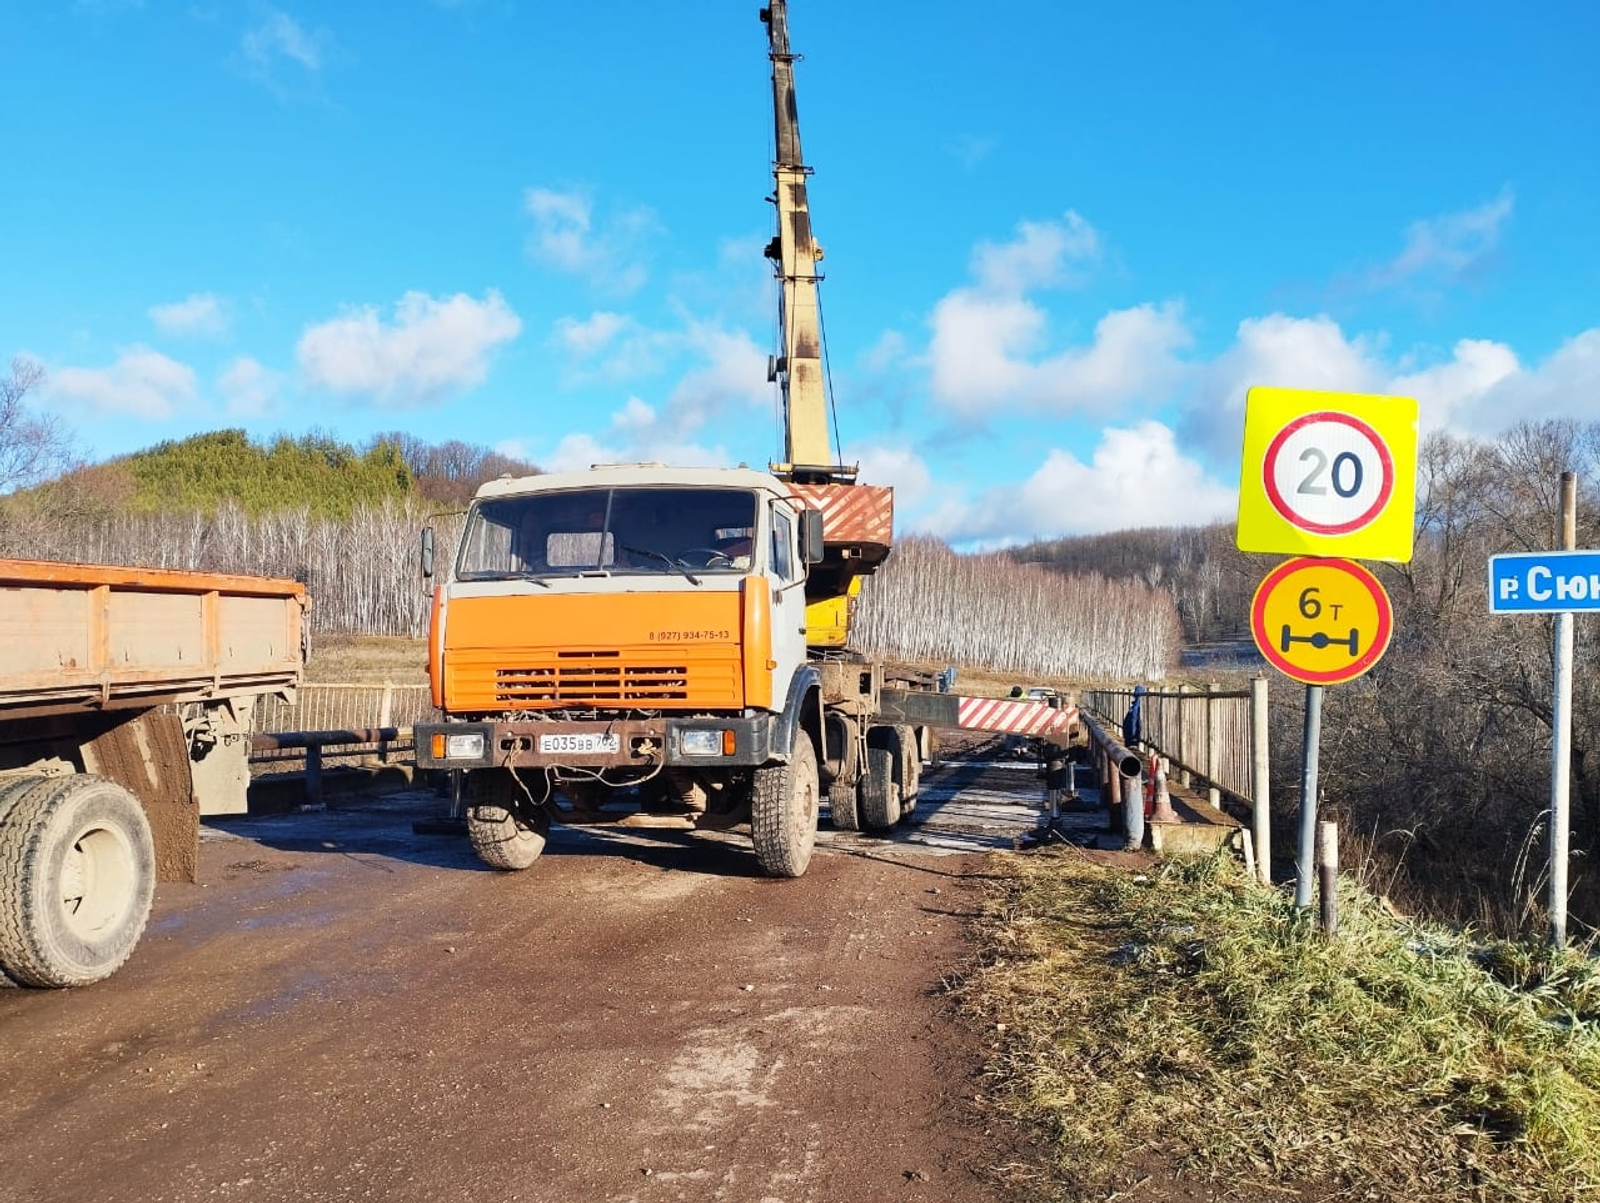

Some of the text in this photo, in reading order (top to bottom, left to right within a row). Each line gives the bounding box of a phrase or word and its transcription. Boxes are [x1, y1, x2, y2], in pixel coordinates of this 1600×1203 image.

[1296, 446, 1364, 499] 20
[658, 631, 681, 642] (927)
[683, 630, 730, 640] 934-75-13
